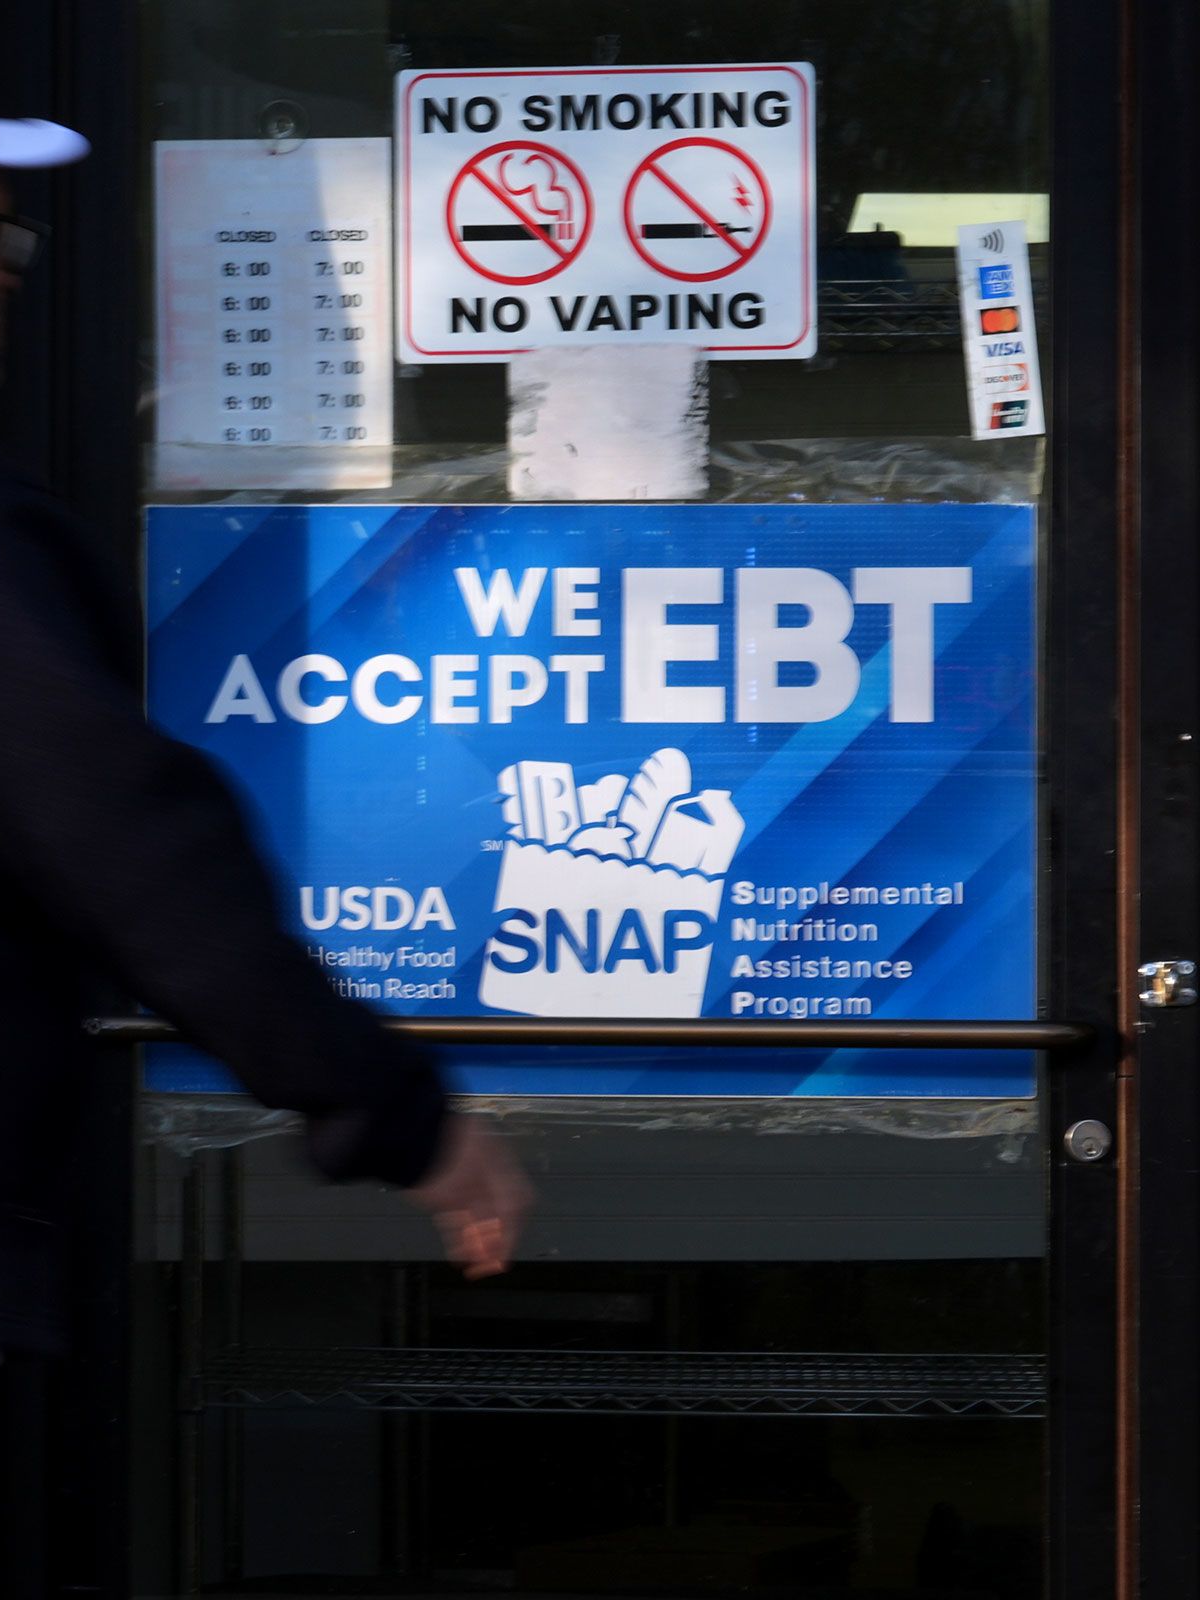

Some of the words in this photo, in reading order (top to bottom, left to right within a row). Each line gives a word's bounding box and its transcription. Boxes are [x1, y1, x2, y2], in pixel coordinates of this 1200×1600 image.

[419, 96, 500, 134] NO
[522, 90, 792, 132] SMOKING
[215, 230, 277, 243] CLOSED
[306, 229, 369, 242] CLOSED
[450, 296, 528, 333] NO
[548, 291, 766, 332] VAPING
[985, 342, 1026, 357] VISA
[453, 566, 601, 637] WE
[620, 566, 973, 724] EBT
[205, 653, 605, 724] ACCEPT
[481, 840, 504, 851] SM
[300, 886, 456, 931] USDA
[731, 881, 964, 910] Supplemental
[490, 907, 717, 974] SNAP
[731, 917, 878, 941] Nutrition
[308, 946, 394, 971] Healthy
[396, 946, 456, 967] Food
[730, 954, 913, 978] Assistance
[327, 977, 381, 998] ithin
[384, 978, 456, 999] Reach
[731, 991, 872, 1019] Program
